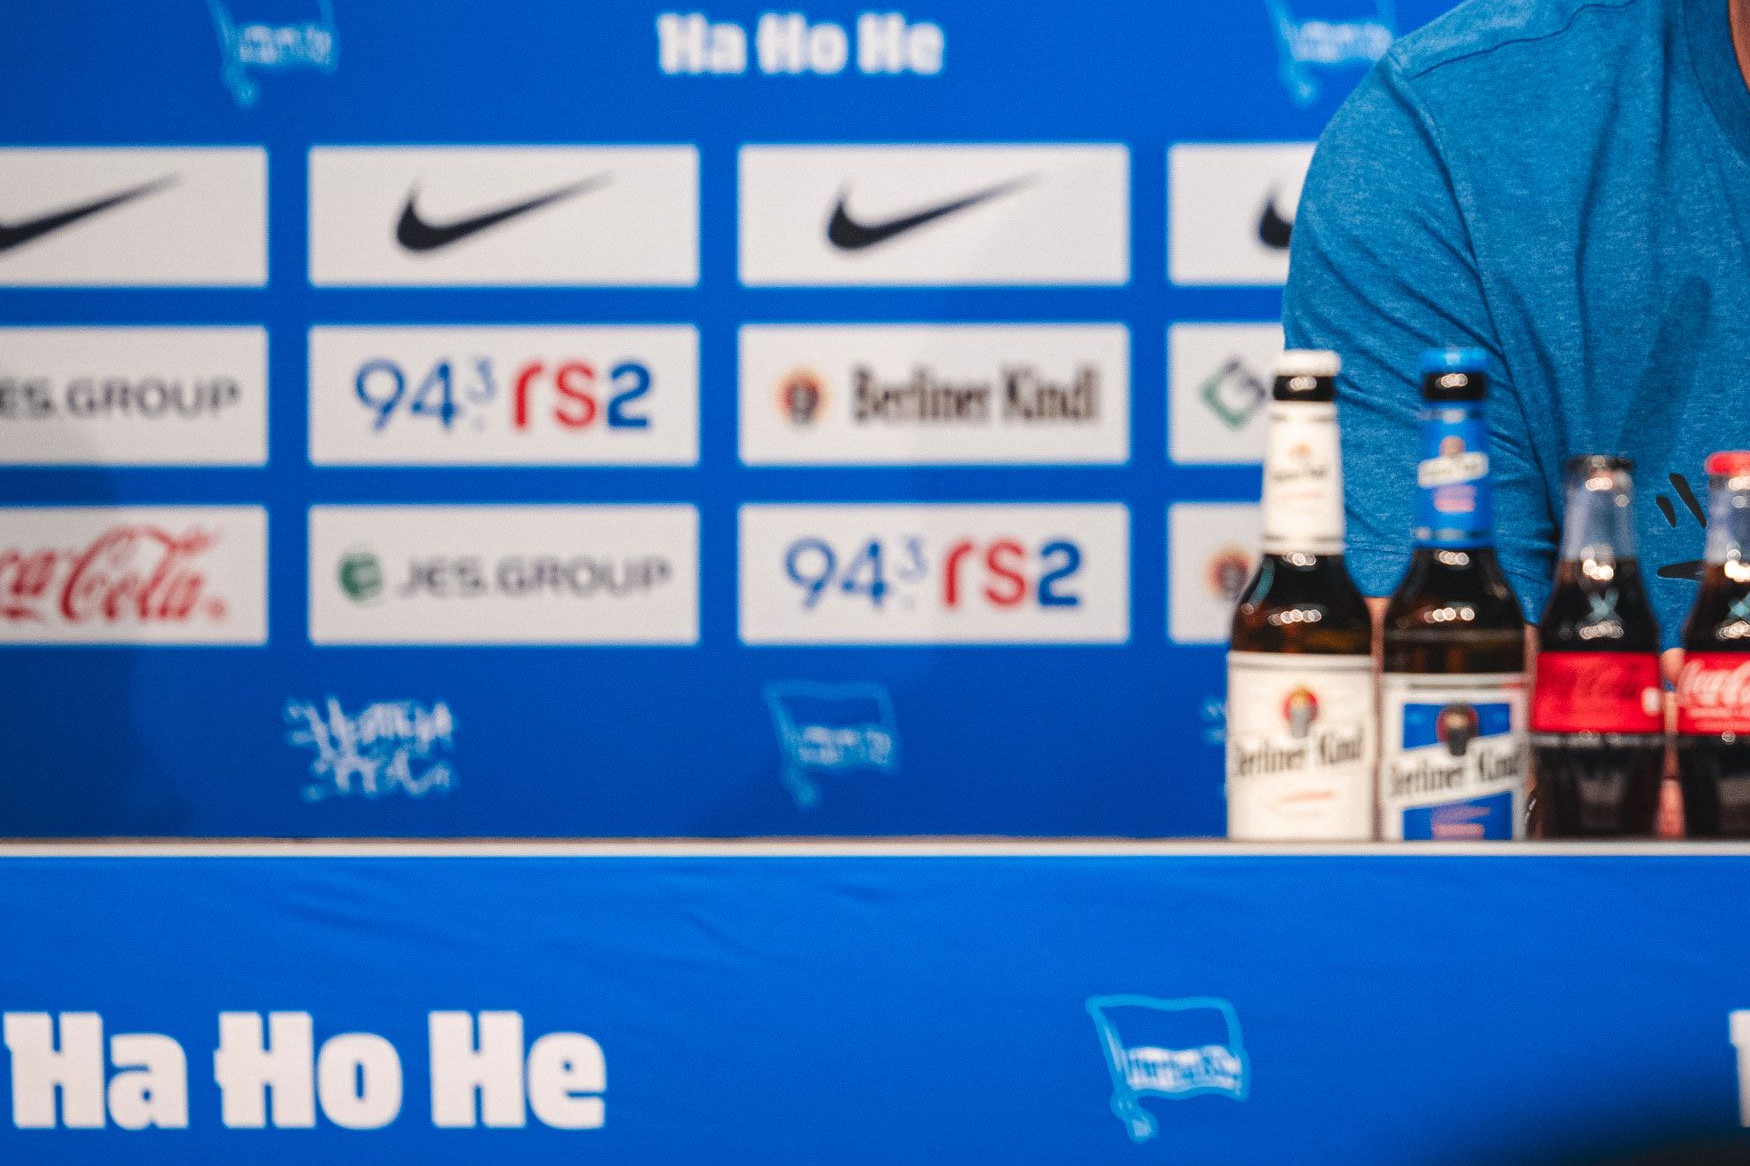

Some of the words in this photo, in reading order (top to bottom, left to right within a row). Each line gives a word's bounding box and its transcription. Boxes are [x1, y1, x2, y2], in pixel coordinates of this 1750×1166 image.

[656, 12, 748, 74] Ha
[755, 12, 849, 74] Ho
[856, 12, 945, 74] He
[852, 363, 993, 427] Berliner
[1000, 362, 1101, 427] Kindl
[4, 1012, 189, 1129] Ha
[213, 1011, 403, 1129] Ho
[428, 1010, 606, 1129] He
